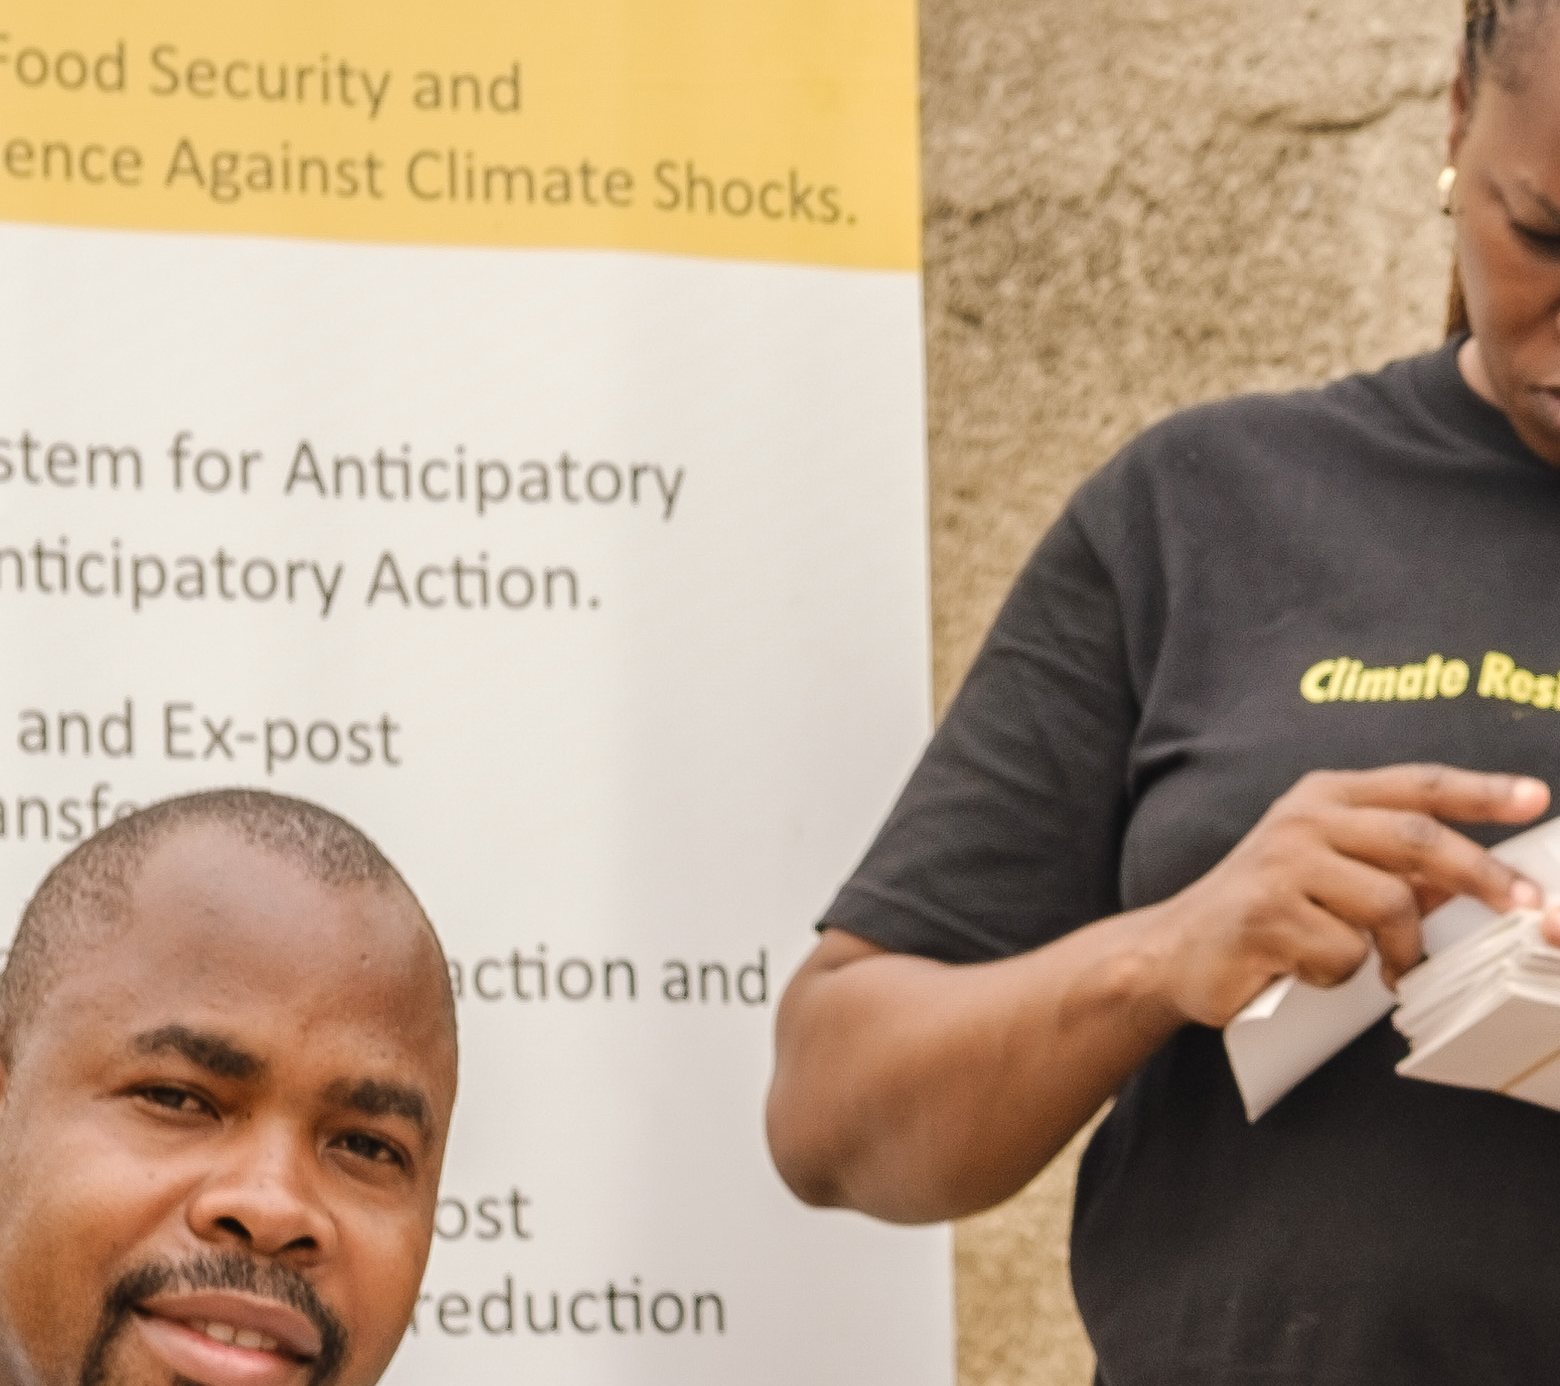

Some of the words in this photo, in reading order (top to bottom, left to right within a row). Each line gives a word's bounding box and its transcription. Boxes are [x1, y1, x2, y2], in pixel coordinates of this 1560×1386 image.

[150, 44, 391, 121] Security
[413, 61, 521, 114] and
[164, 137, 383, 204] Against
[406, 148, 635, 208] Climate
[653, 159, 856, 226] Shocks.
[168, 431, 262, 493] for
[284, 440, 685, 522] Anticipatory
[366, 550, 600, 610] Action.
[1299, 652, 1470, 705] Climate
[18, 698, 134, 758] and
[163, 703, 400, 776] Ex-post
[662, 949, 768, 1006] and
